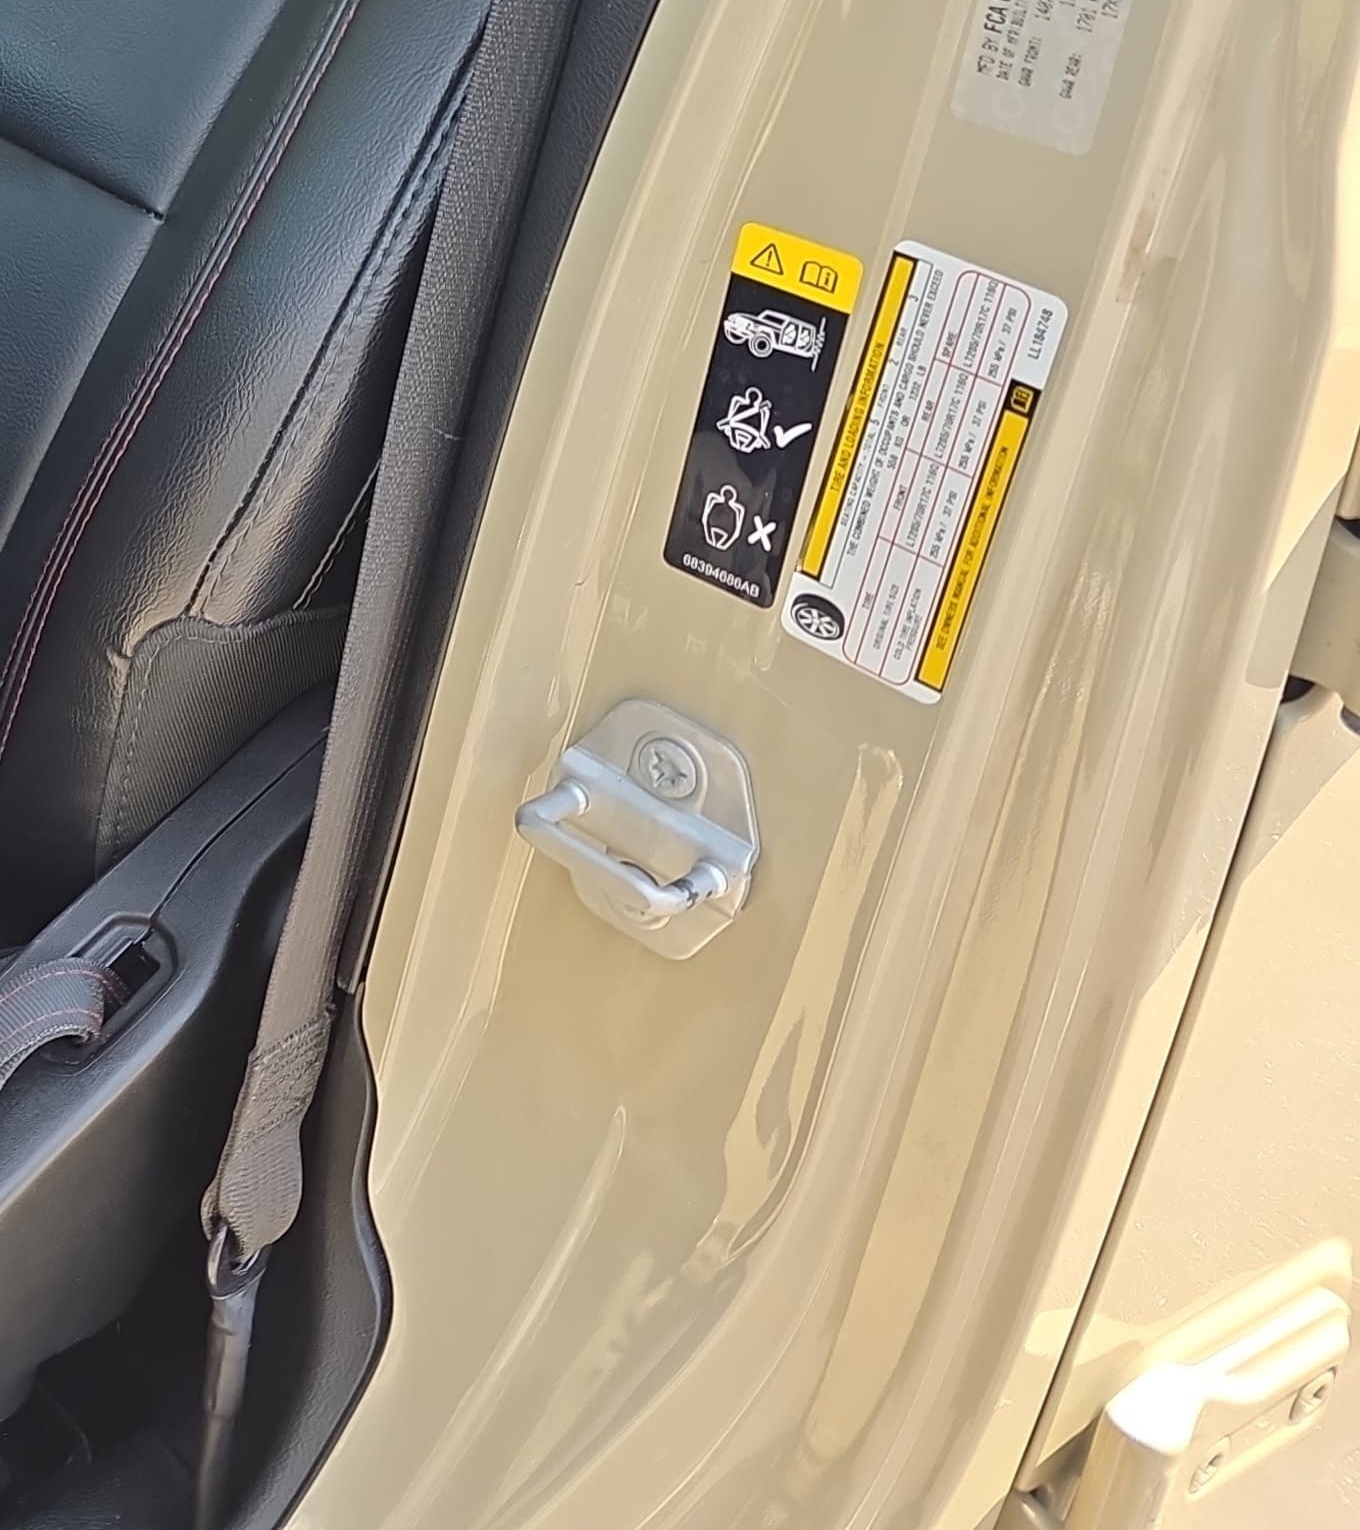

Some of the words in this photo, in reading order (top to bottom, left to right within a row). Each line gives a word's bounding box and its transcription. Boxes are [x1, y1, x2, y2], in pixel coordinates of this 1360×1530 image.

[982, 2, 1009, 34] FCA
[980, 36, 1000, 53] BY
[975, 53, 995, 76] MFD
[925, 268, 944, 302] EXCEED
[917, 300, 934, 329] NEVER
[1001, 322, 1013, 335] 37
[1005, 306, 1018, 323] PSI
[906, 328, 925, 363] SHOULD
[940, 330, 957, 359] SPARE
[1026, 306, 1054, 361] LL184748
[855, 340, 885, 407] INFORMATION
[897, 361, 915, 392] CARGO
[892, 390, 906, 409] AND
[892, 434, 904, 448] KG
[899, 413, 911, 428] OR
[915, 363, 927, 377] LB
[920, 398, 935, 423] REAR
[975, 399, 988, 415] PSI
[842, 405, 865, 450] LOADING
[877, 407, 900, 457] OCCUPANTS
[971, 414, 983, 428] 37
[836, 448, 852, 471] AND
[873, 455, 885, 468] OF
[983, 444, 1008, 501] INFORMATION
[829, 469, 845, 493] TIRE
[864, 467, 881, 499] WEIGHT
[892, 483, 908, 511] FRONT
[941, 504, 953, 518] 37
[945, 488, 958, 506] PSI
[851, 498, 872, 541] COMBINED
[845, 539, 859, 558] THE
[928, 542, 941, 559] 255
[871, 616, 889, 651] ORIGINAL
[887, 582, 900, 601] SIZE
